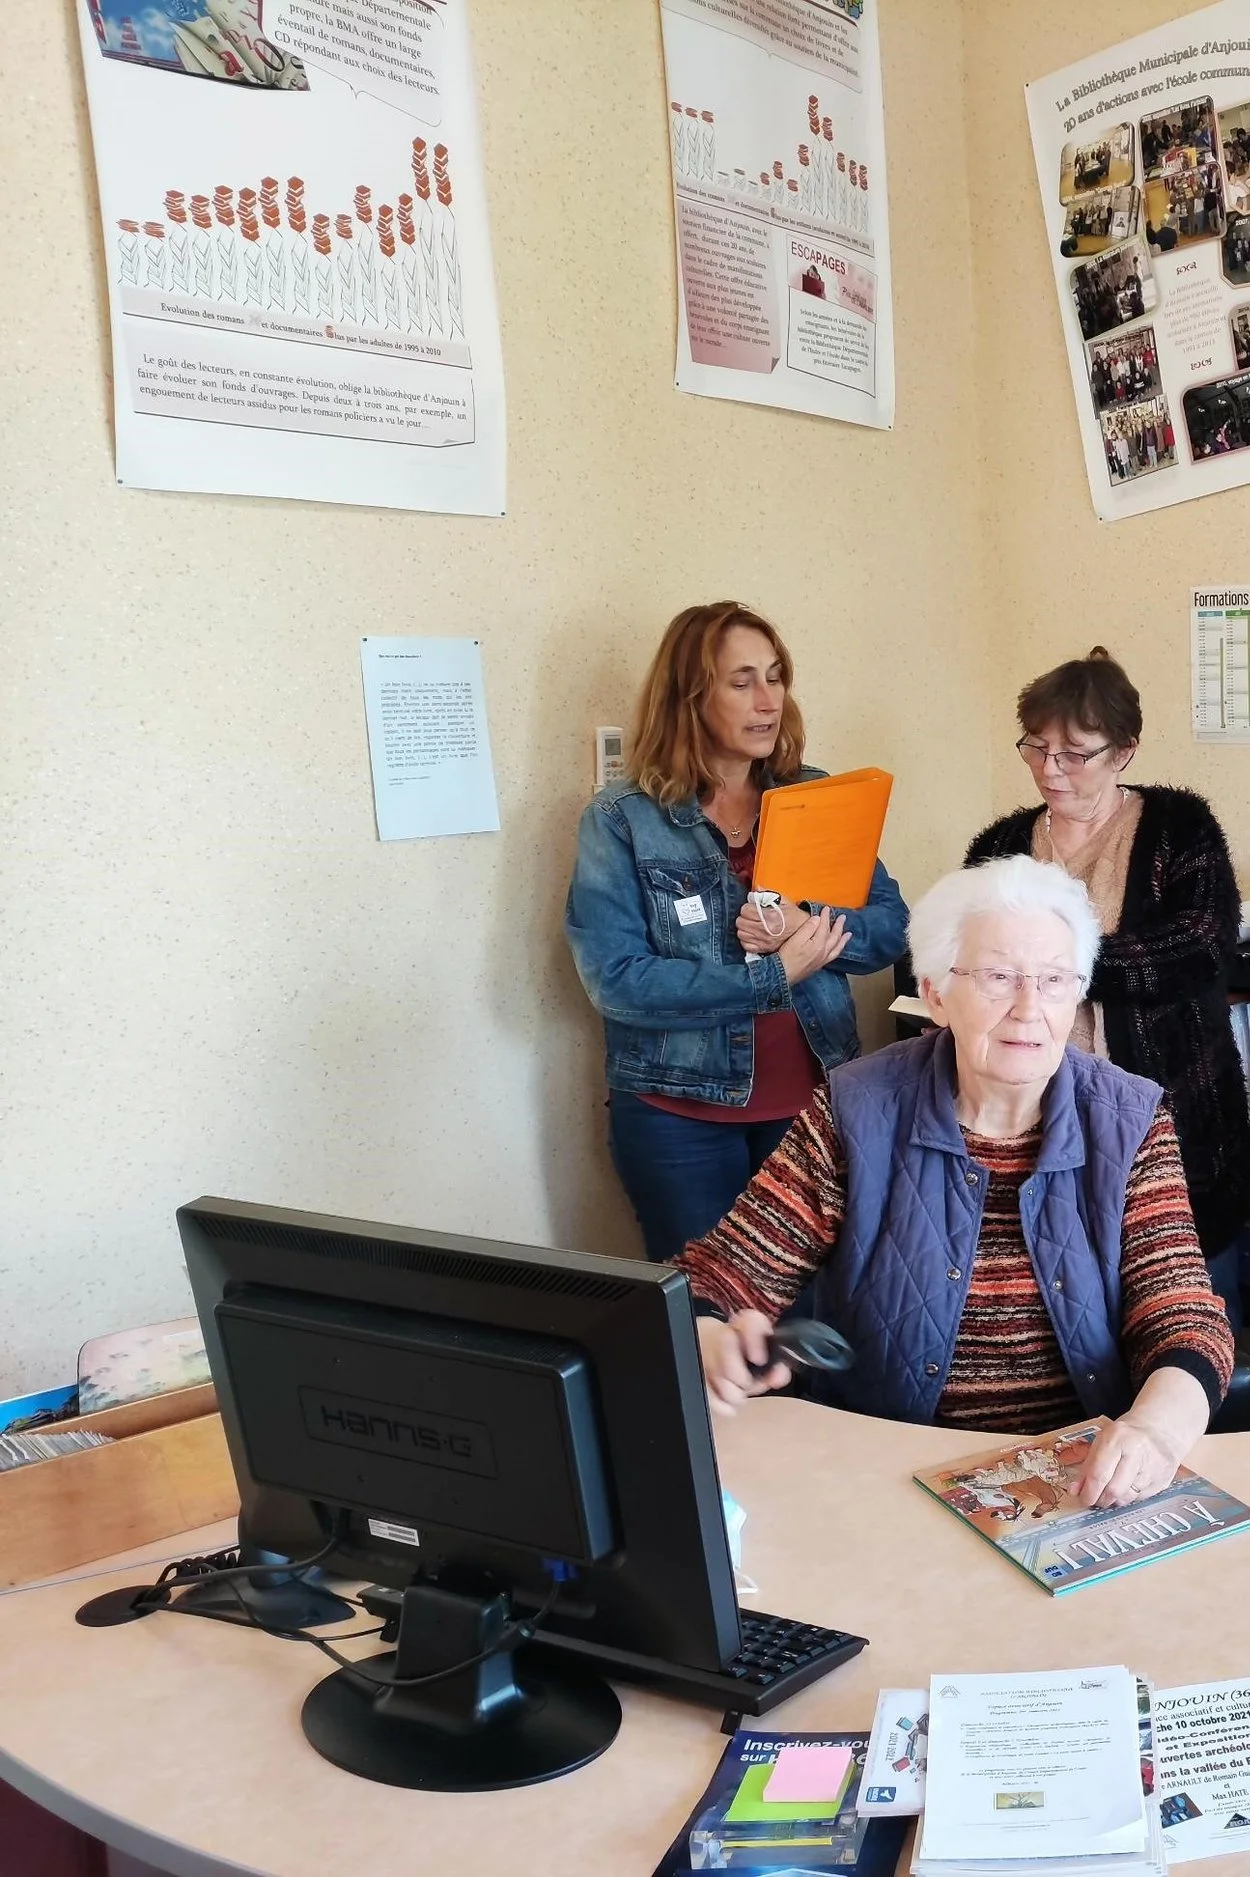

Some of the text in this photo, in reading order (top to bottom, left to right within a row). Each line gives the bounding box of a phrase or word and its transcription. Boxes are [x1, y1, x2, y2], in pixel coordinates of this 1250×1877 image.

[278, 14, 316, 36] éventail
[318, 28, 329, 41] de
[325, 12, 333, 26] la
[337, 18, 360, 36] BMA
[362, 30, 383, 44] offre
[386, 38, 397, 49] un
[399, 41, 421, 59] large
[332, 3, 354, 18] mais
[356, 12, 378, 27] aussi
[380, 21, 396, 33] son
[399, 26, 422, 42] fonds
[274, 30, 290, 44] CD
[294, 37, 341, 62] répondant
[344, 56, 360, 68] aux
[363, 61, 386, 77] choix
[388, 70, 402, 82] des
[1055, 98, 1070, 112] La
[1072, 66, 1137, 101] Bibliothèque
[1139, 45, 1198, 73] Municipale
[1064, 117, 1076, 133] 20
[1078, 107, 1095, 124] ans
[1096, 88, 1139, 114] d'actions
[1141, 81, 1163, 97] avec
[1166, 71, 1198, 89] l'école
[791, 240, 846, 275] ESCAPAGES
[137, 368, 158, 380] faire
[163, 372, 197, 385] évoluer
[202, 379, 217, 388] son
[222, 380, 246, 391] fonds
[302, 391, 330, 404] Depuis
[334, 396, 353, 405] deux
[364, 400, 382, 409] trois
[405, 406, 417, 415] par
[143, 354, 154, 364] Le
[157, 358, 178, 368] goût
[181, 360, 196, 370] des
[239, 369, 250, 377] en
[252, 370, 293, 384] constante
[339, 383, 362, 395] oblige
[364, 385, 371, 395] la
[373, 387, 422, 401] bibliothèque
[423, 393, 460, 406] d'Anjouin
[462, 399, 466, 407] à
[140, 386, 196, 401] engouement
[198, 392, 209, 401] de
[211, 394, 249, 406] lecteurs
[247, 400, 276, 410] assidus
[279, 403, 298, 413] pour
[301, 404, 311, 414] les
[313, 408, 342, 418] romans
[344, 411, 378, 423] policiers
[397, 416, 404, 426] le
[1194, 592, 1249, 607] Formations
[1183, 1500, 1225, 1527] À
[1069, 1512, 1192, 1563] CHEVAL
[1154, 1690, 1229, 1712] NJOUIN
[1170, 1706, 1213, 1721] associatif
[1215, 1705, 1224, 1713] et
[1175, 1719, 1188, 1730] 10
[1189, 1714, 1227, 1729] octobre
[740, 1753, 766, 1762] sur
[744, 1739, 871, 1751] Inscrivez-vou
[1160, 1749, 1202, 1764] uvertes
[1166, 1776, 1202, 1789] ARNAULT
[1203, 1775, 1212, 1783] de
[1213, 1772, 1238, 1782] Romain
[1180, 1766, 1190, 1776] la
[1192, 1760, 1227, 1774] vallée
[1230, 1759, 1244, 1768] du
[1211, 1788, 1250, 1801] Max HATE
